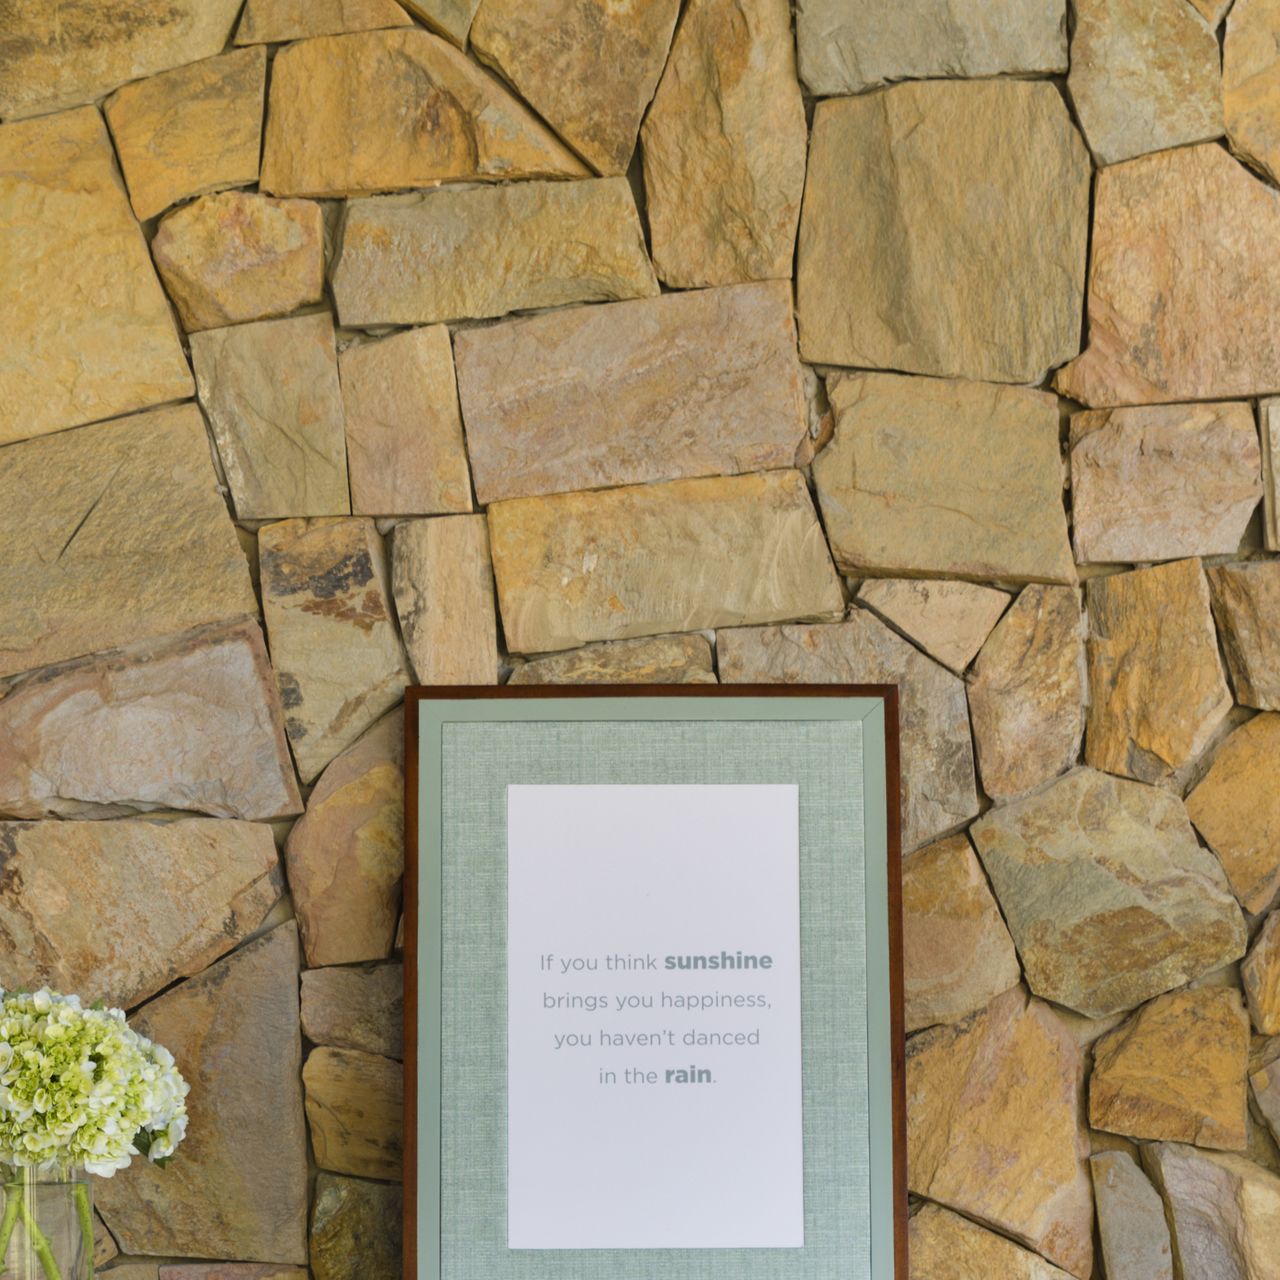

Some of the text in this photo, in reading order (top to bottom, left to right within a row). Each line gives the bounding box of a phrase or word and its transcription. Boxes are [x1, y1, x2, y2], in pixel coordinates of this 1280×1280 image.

[540, 951, 773, 974] If you think sunshine
[543, 991, 772, 1012] brings you happiness,
[554, 1029, 760, 1050] you haven’t danced
[600, 1065, 717, 1084] in the rain.
